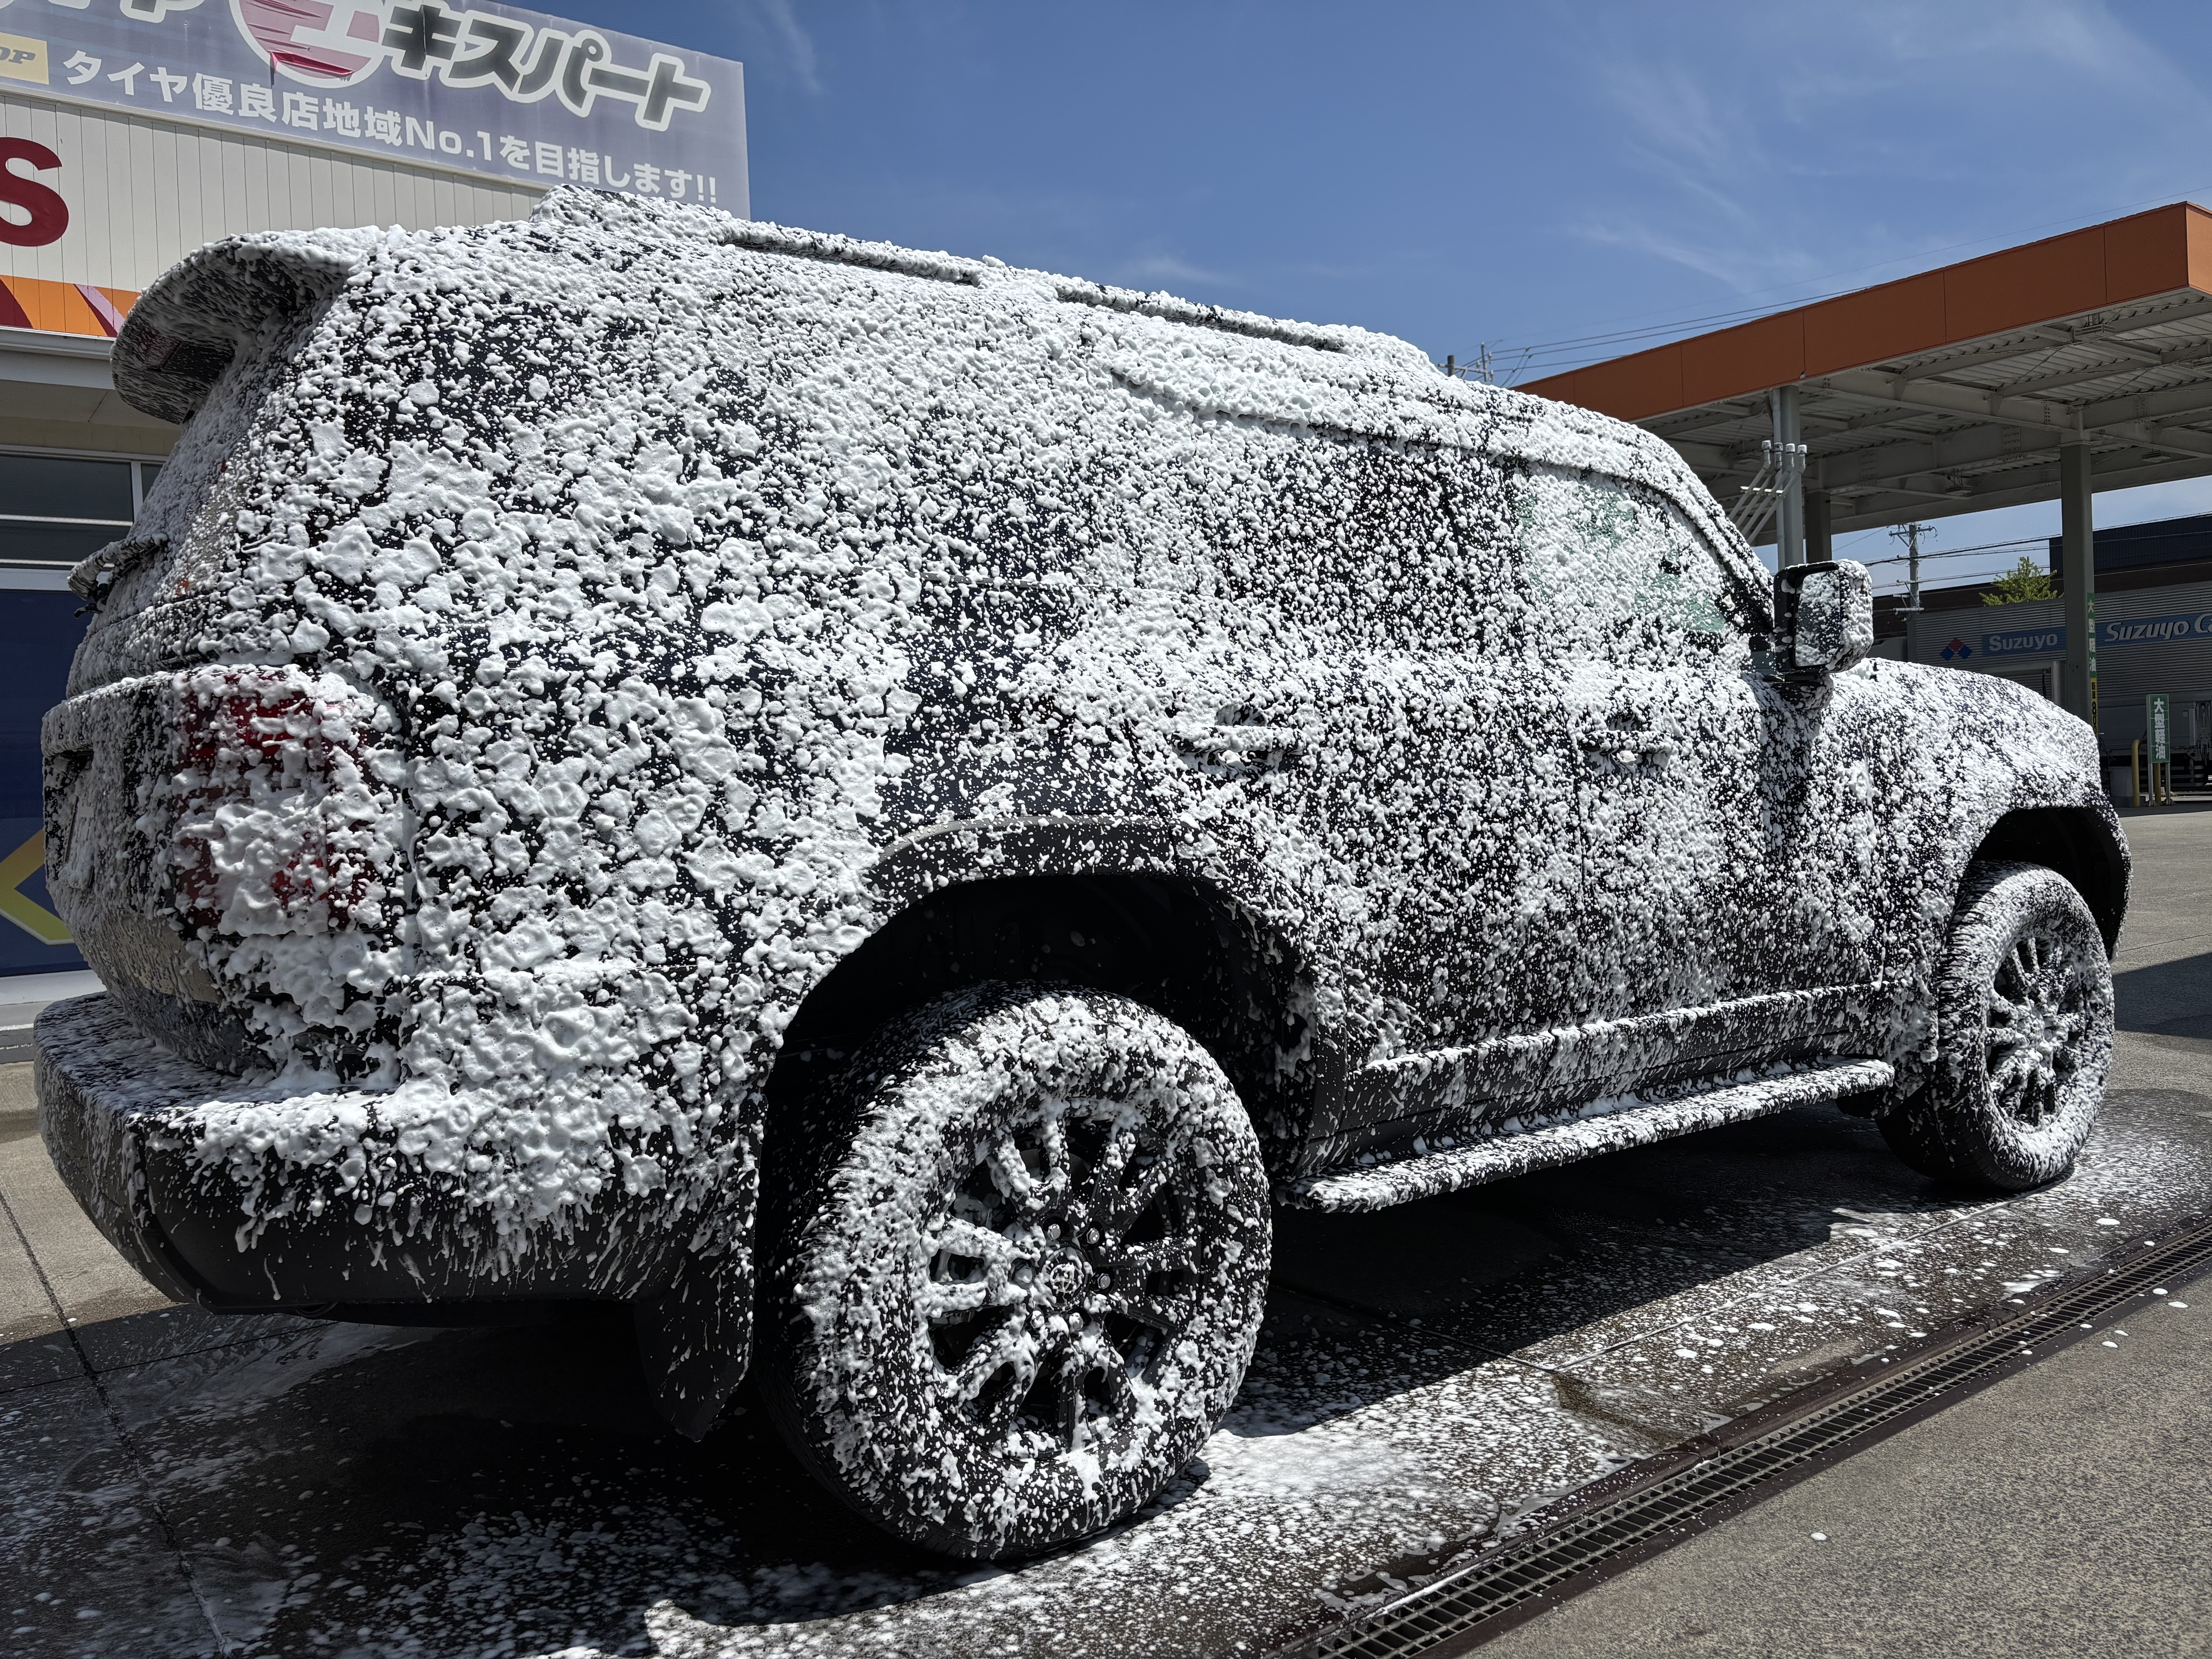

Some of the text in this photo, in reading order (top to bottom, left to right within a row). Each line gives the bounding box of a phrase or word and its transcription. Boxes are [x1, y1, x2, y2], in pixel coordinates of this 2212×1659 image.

[2105, 613, 2212, 641] Suzuyo C
[1989, 634, 2057, 651] Suzuyo
[2154, 698, 2166, 759] 大型軽油
